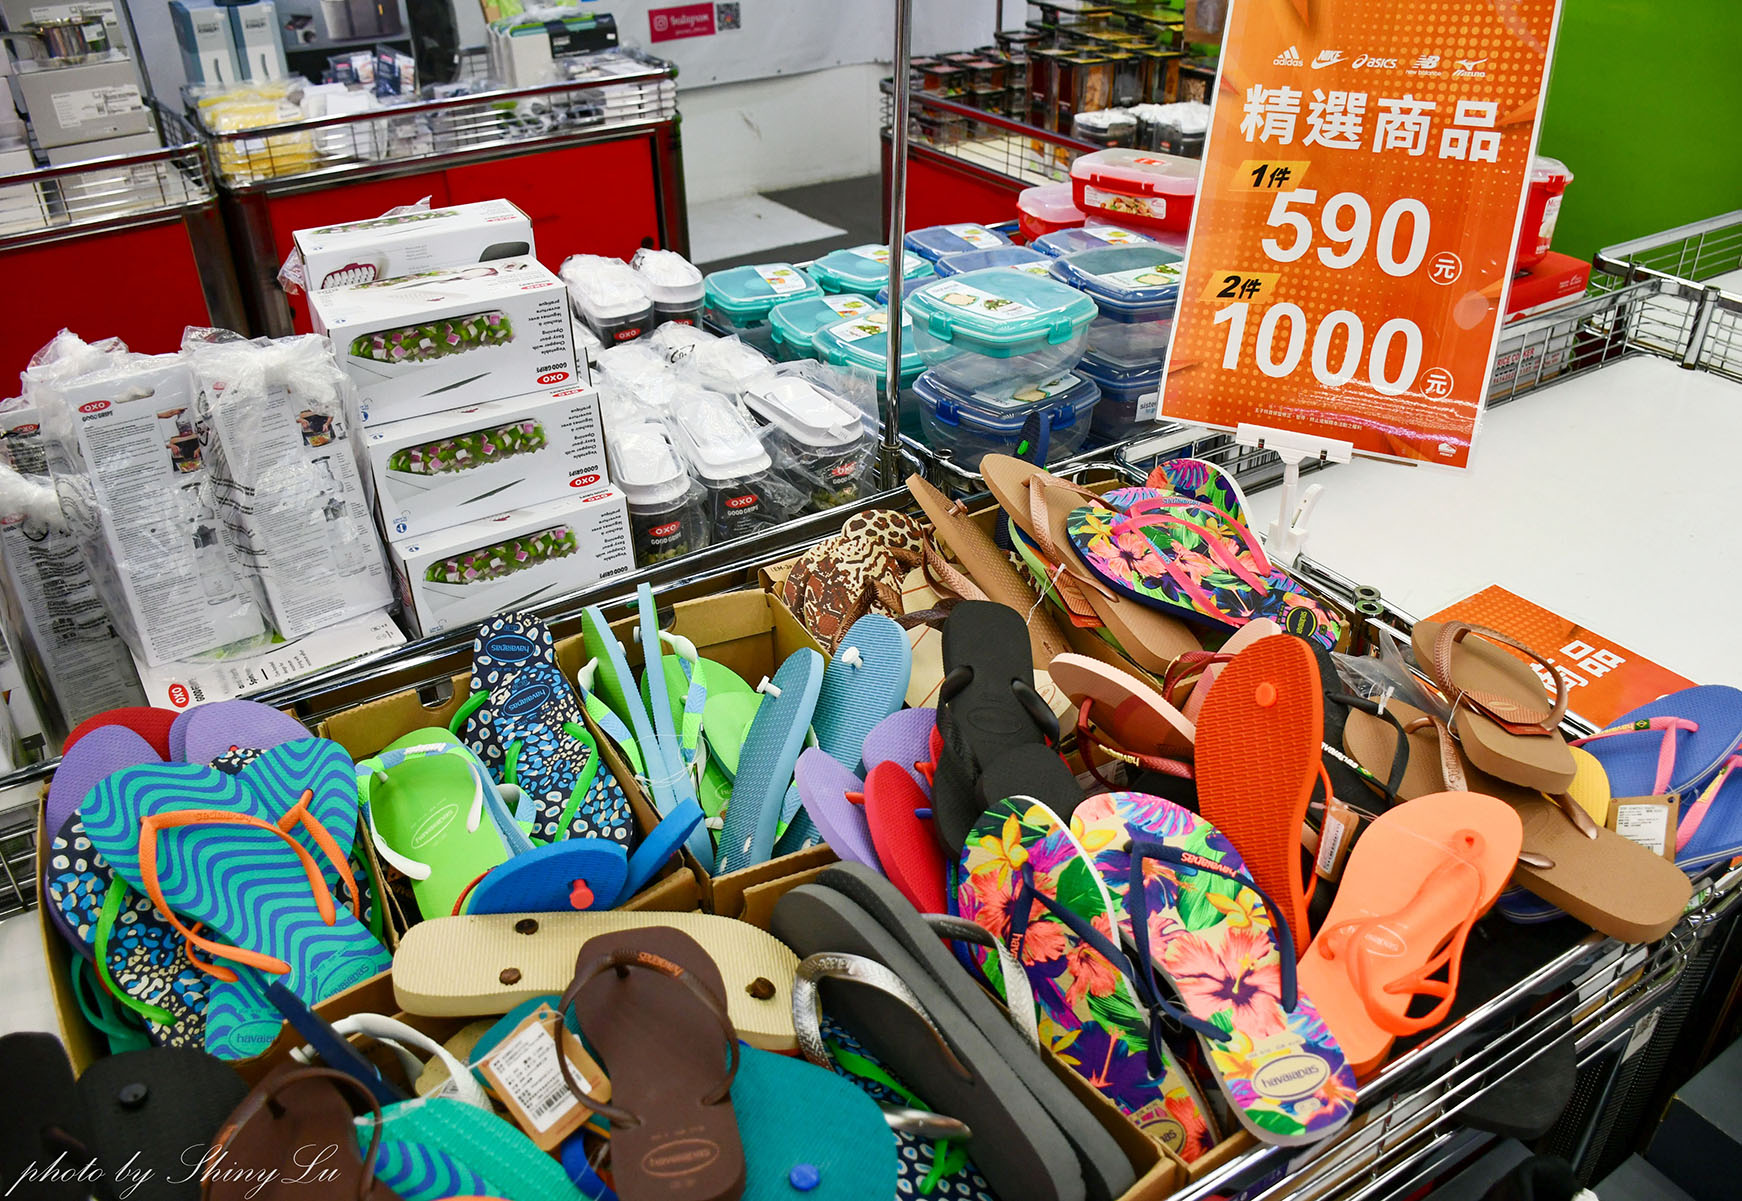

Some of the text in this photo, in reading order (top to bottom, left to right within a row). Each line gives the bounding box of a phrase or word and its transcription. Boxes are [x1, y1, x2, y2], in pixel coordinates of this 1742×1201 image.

[1318, 49, 1345, 62] NIKE
[1272, 57, 1304, 67] adidas
[1240, 83, 1502, 164] 精選商品
[1250, 163, 1292, 189] 1件
[1260, 188, 1432, 278] 590
[1216, 275, 1263, 300] 2件
[618, 329, 637, 340] OXO
[541, 347, 566, 355] Vegetable
[1212, 301, 1424, 397] 1000
[1511, 347, 1535, 361] COKER
[536, 362, 568, 373] GOOD GRIPS
[542, 373, 564, 383] OXO
[84, 402, 106, 412] OXO
[574, 432, 595, 440] Opening
[573, 451, 597, 459] Vegetable
[568, 465, 599, 477] GOOD GRIPS
[574, 476, 595, 486] OXO
[731, 496, 753, 508] OXO
[727, 508, 744, 516] GOOD
[655, 523, 677, 536] OXO
[613, 565, 629, 575] GOOD
[490, 643, 531, 654] havaianas
[171, 687, 187, 704] OXO
[508, 688, 547, 711] havaianas
[1180, 852, 1238, 878] havaianas
[1260, 1063, 1320, 1089] havaianas
